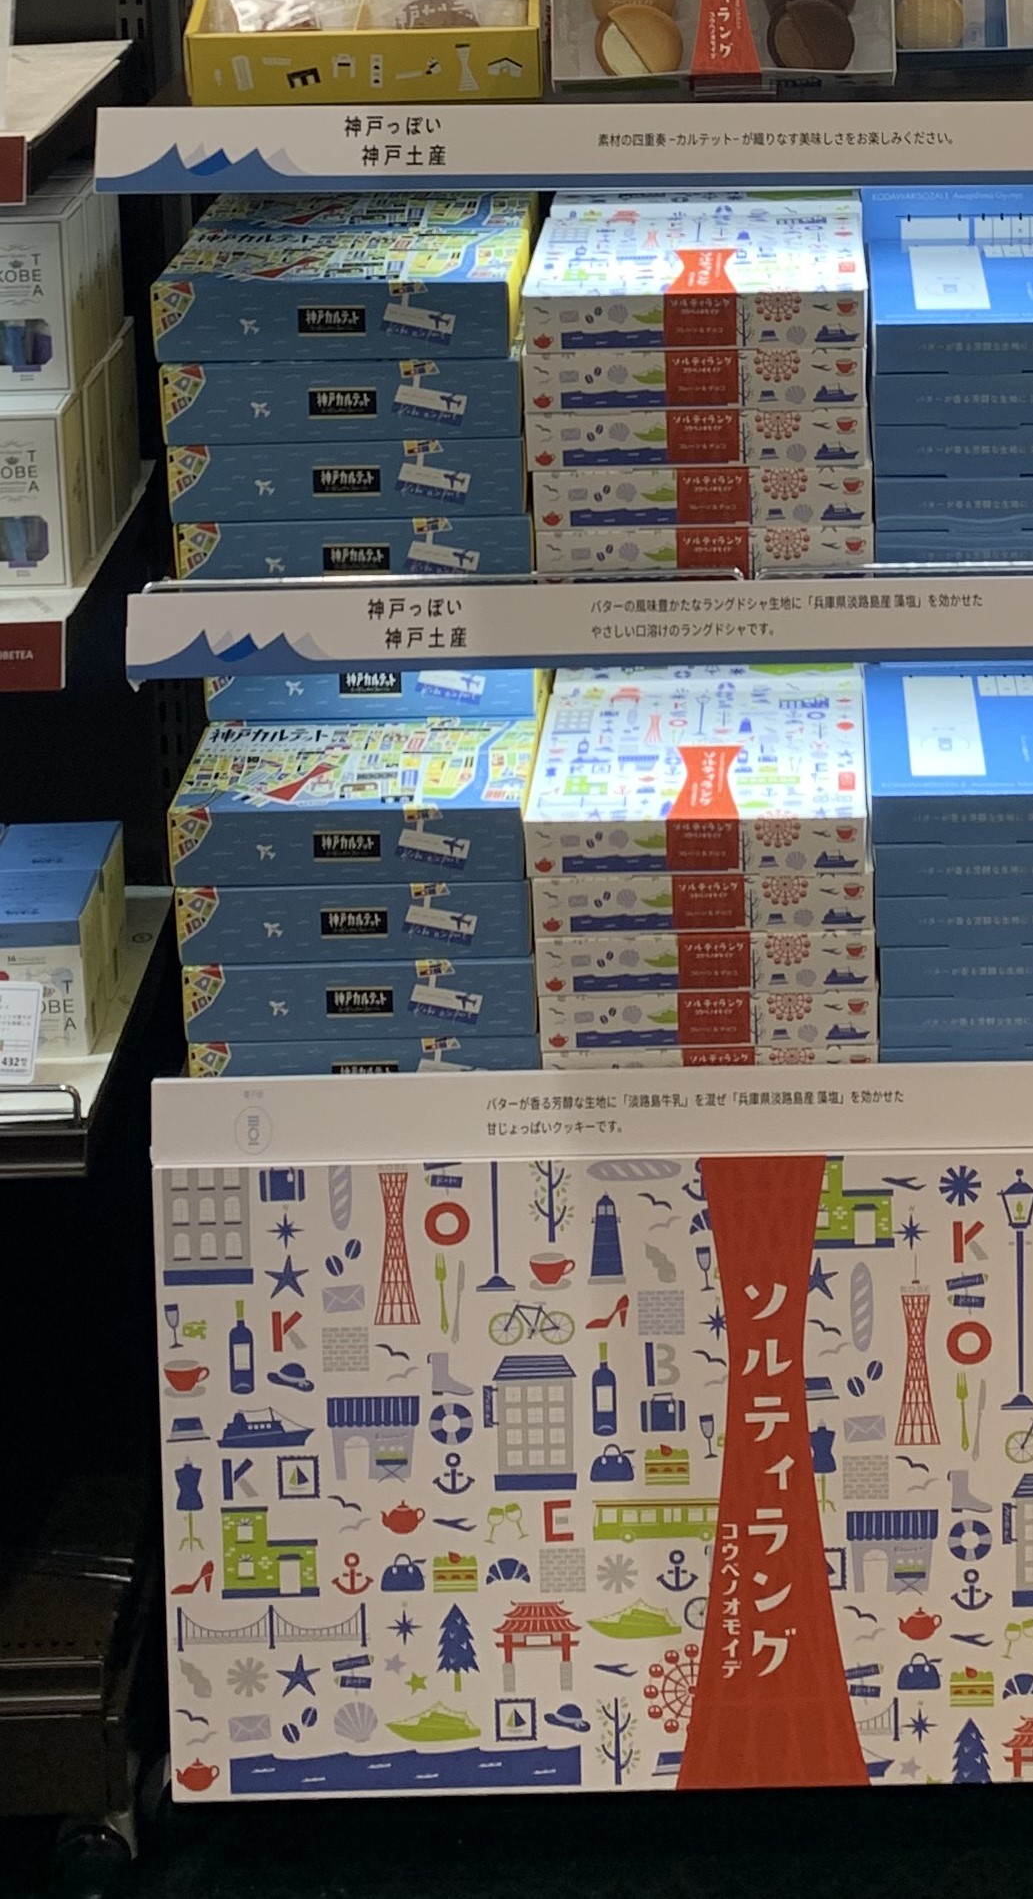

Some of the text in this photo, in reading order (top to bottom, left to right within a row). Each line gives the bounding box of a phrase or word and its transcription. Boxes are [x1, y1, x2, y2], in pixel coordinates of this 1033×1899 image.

[344, 115, 441, 137] 神戸っぽい
[362, 144, 446, 167] 神戸土産
[305, 309, 360, 325] 神戸カルテット
[316, 392, 371, 408] 神戸カルテット
[320, 470, 375, 486] 神戸カルテット
[330, 548, 385, 564] 神戸カルテット
[367, 598, 462, 620] 神戸っぽい
[385, 626, 467, 650] 神戸土産
[209, 727, 329, 744] 神戸カルテット
[321, 835, 376, 851] 神戸カルテット
[327, 912, 382, 928] 神戸カルテット
[334, 991, 388, 1007] 神戸カルテット
[487, 1121, 623, 1136] 甘じょっぱいクッキーです。
[742, 1280, 798, 1679] ソルティラング
[720, 1522, 743, 1680] コウベノオモイデ
